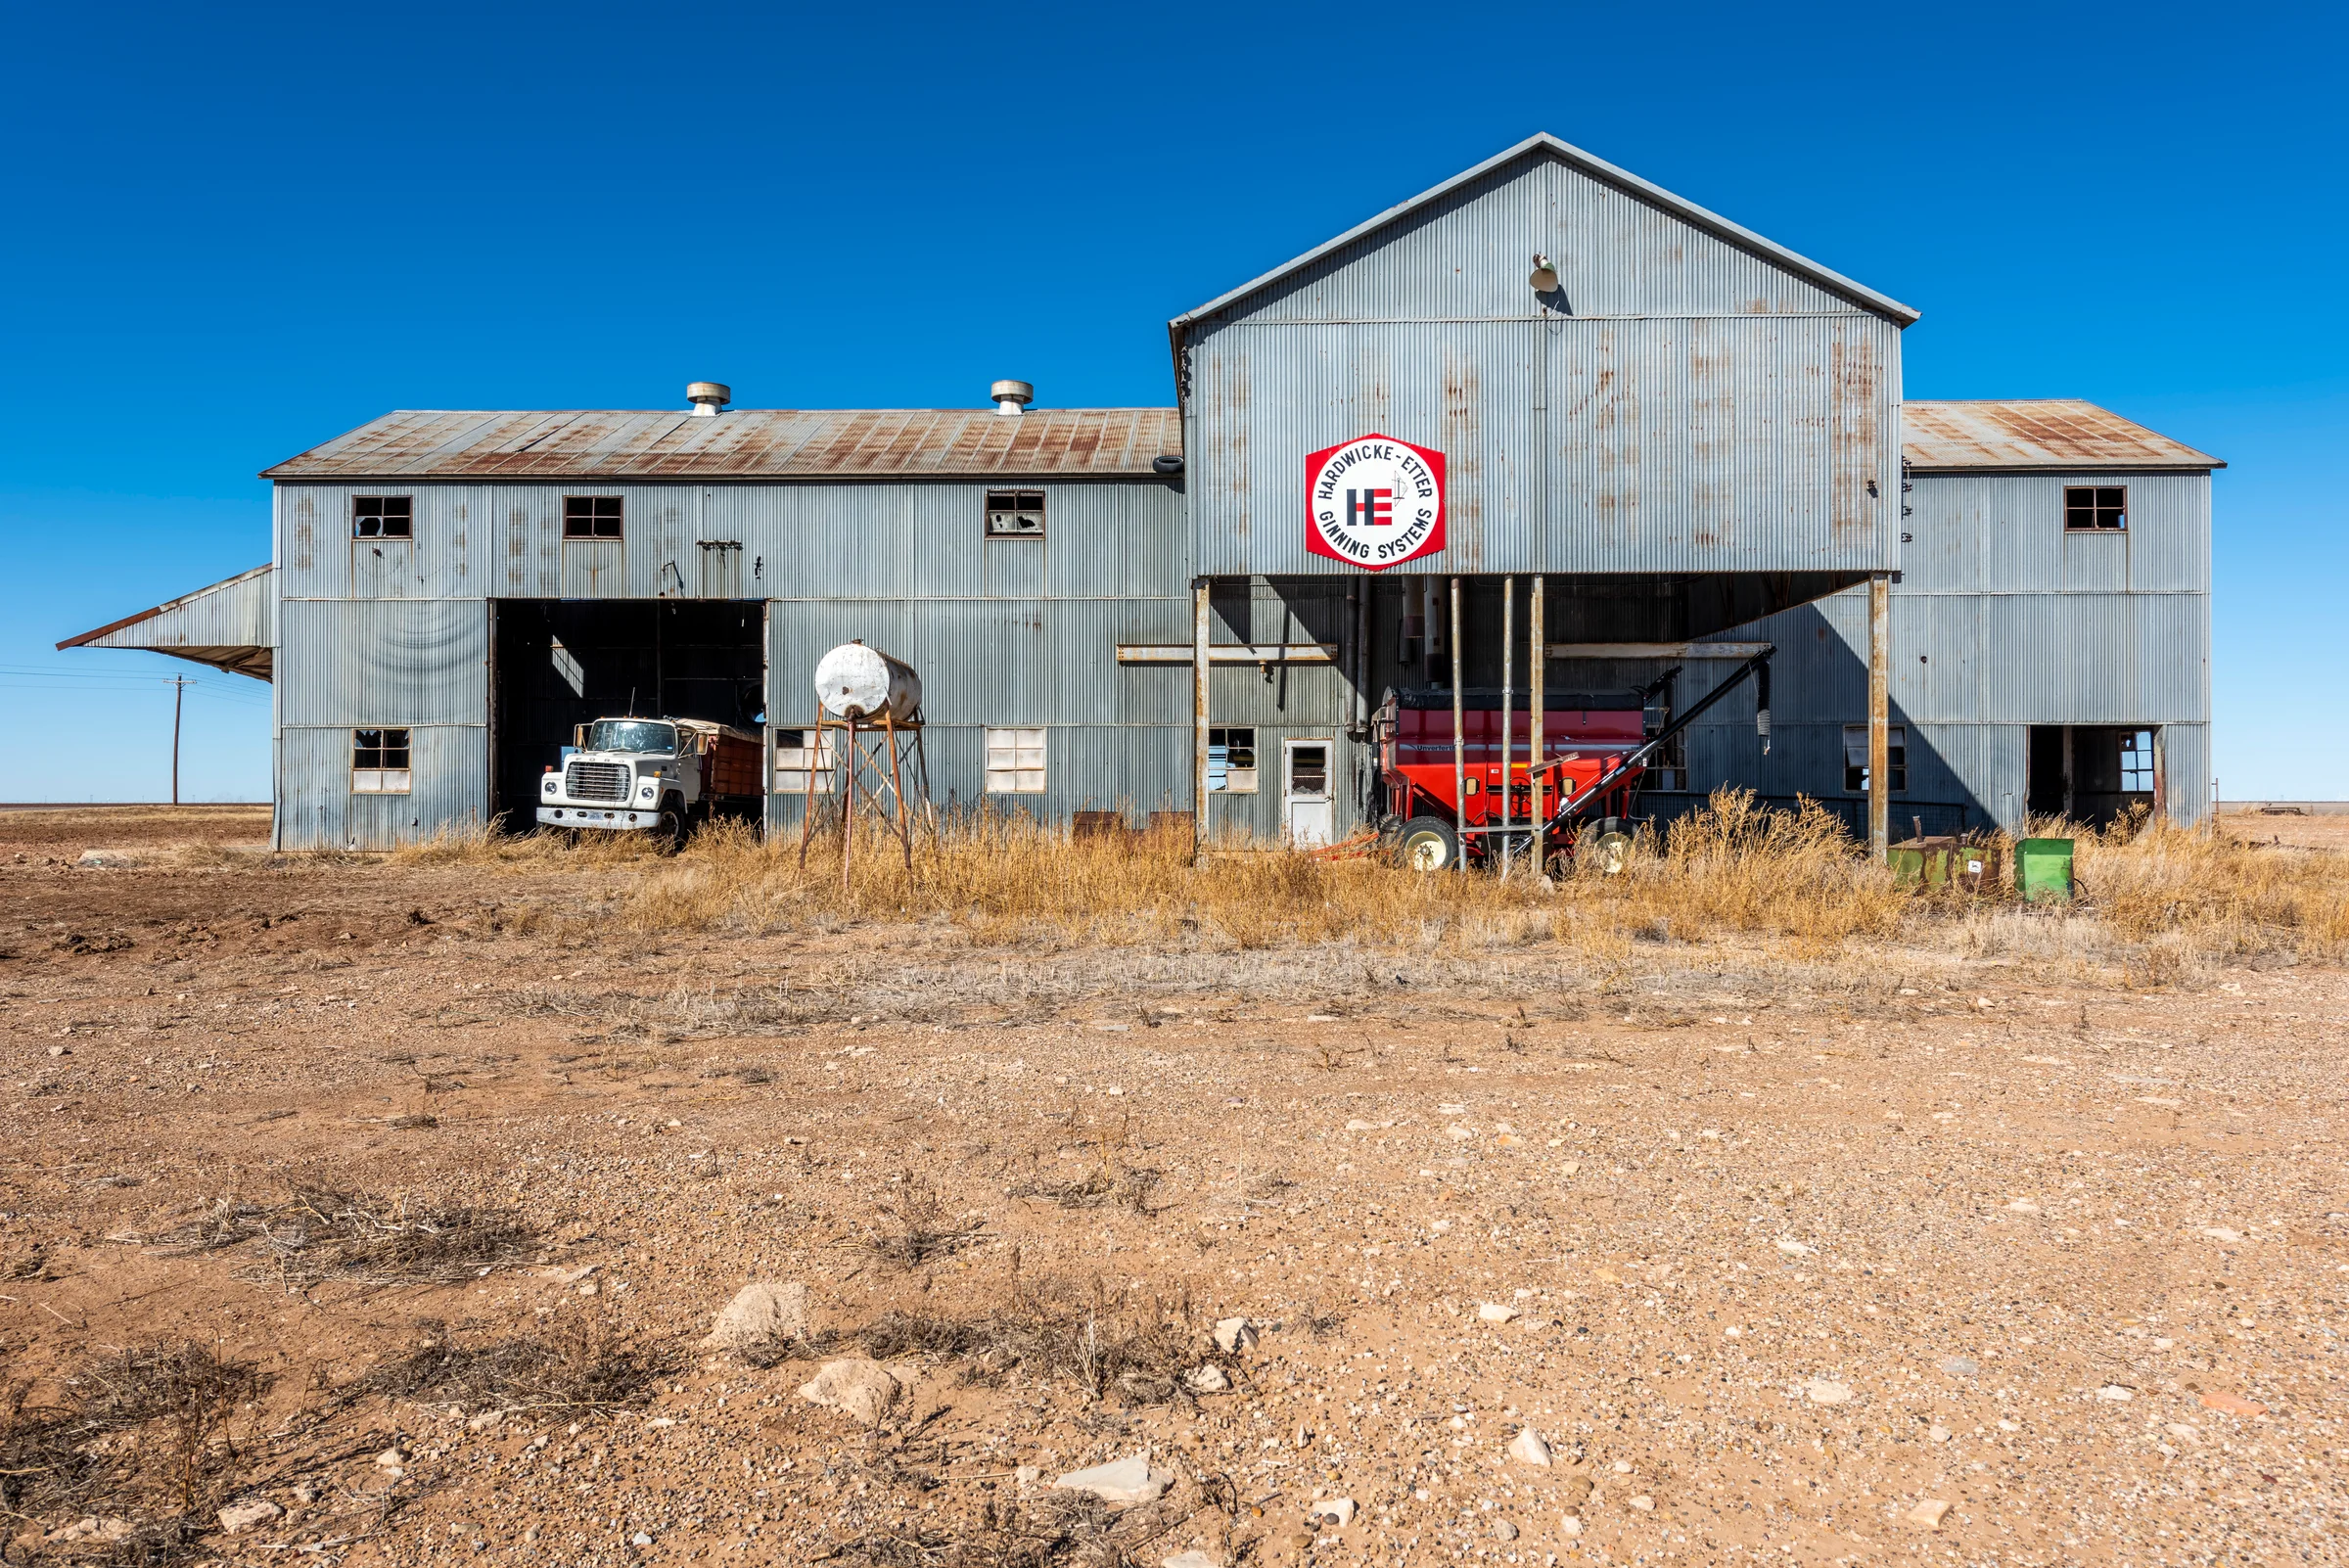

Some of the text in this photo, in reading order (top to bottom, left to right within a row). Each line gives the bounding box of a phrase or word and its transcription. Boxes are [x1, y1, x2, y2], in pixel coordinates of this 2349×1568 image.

[1346, 488, 1393, 527] HE
[1318, 508, 1432, 559] GINNING SYSTEMS
